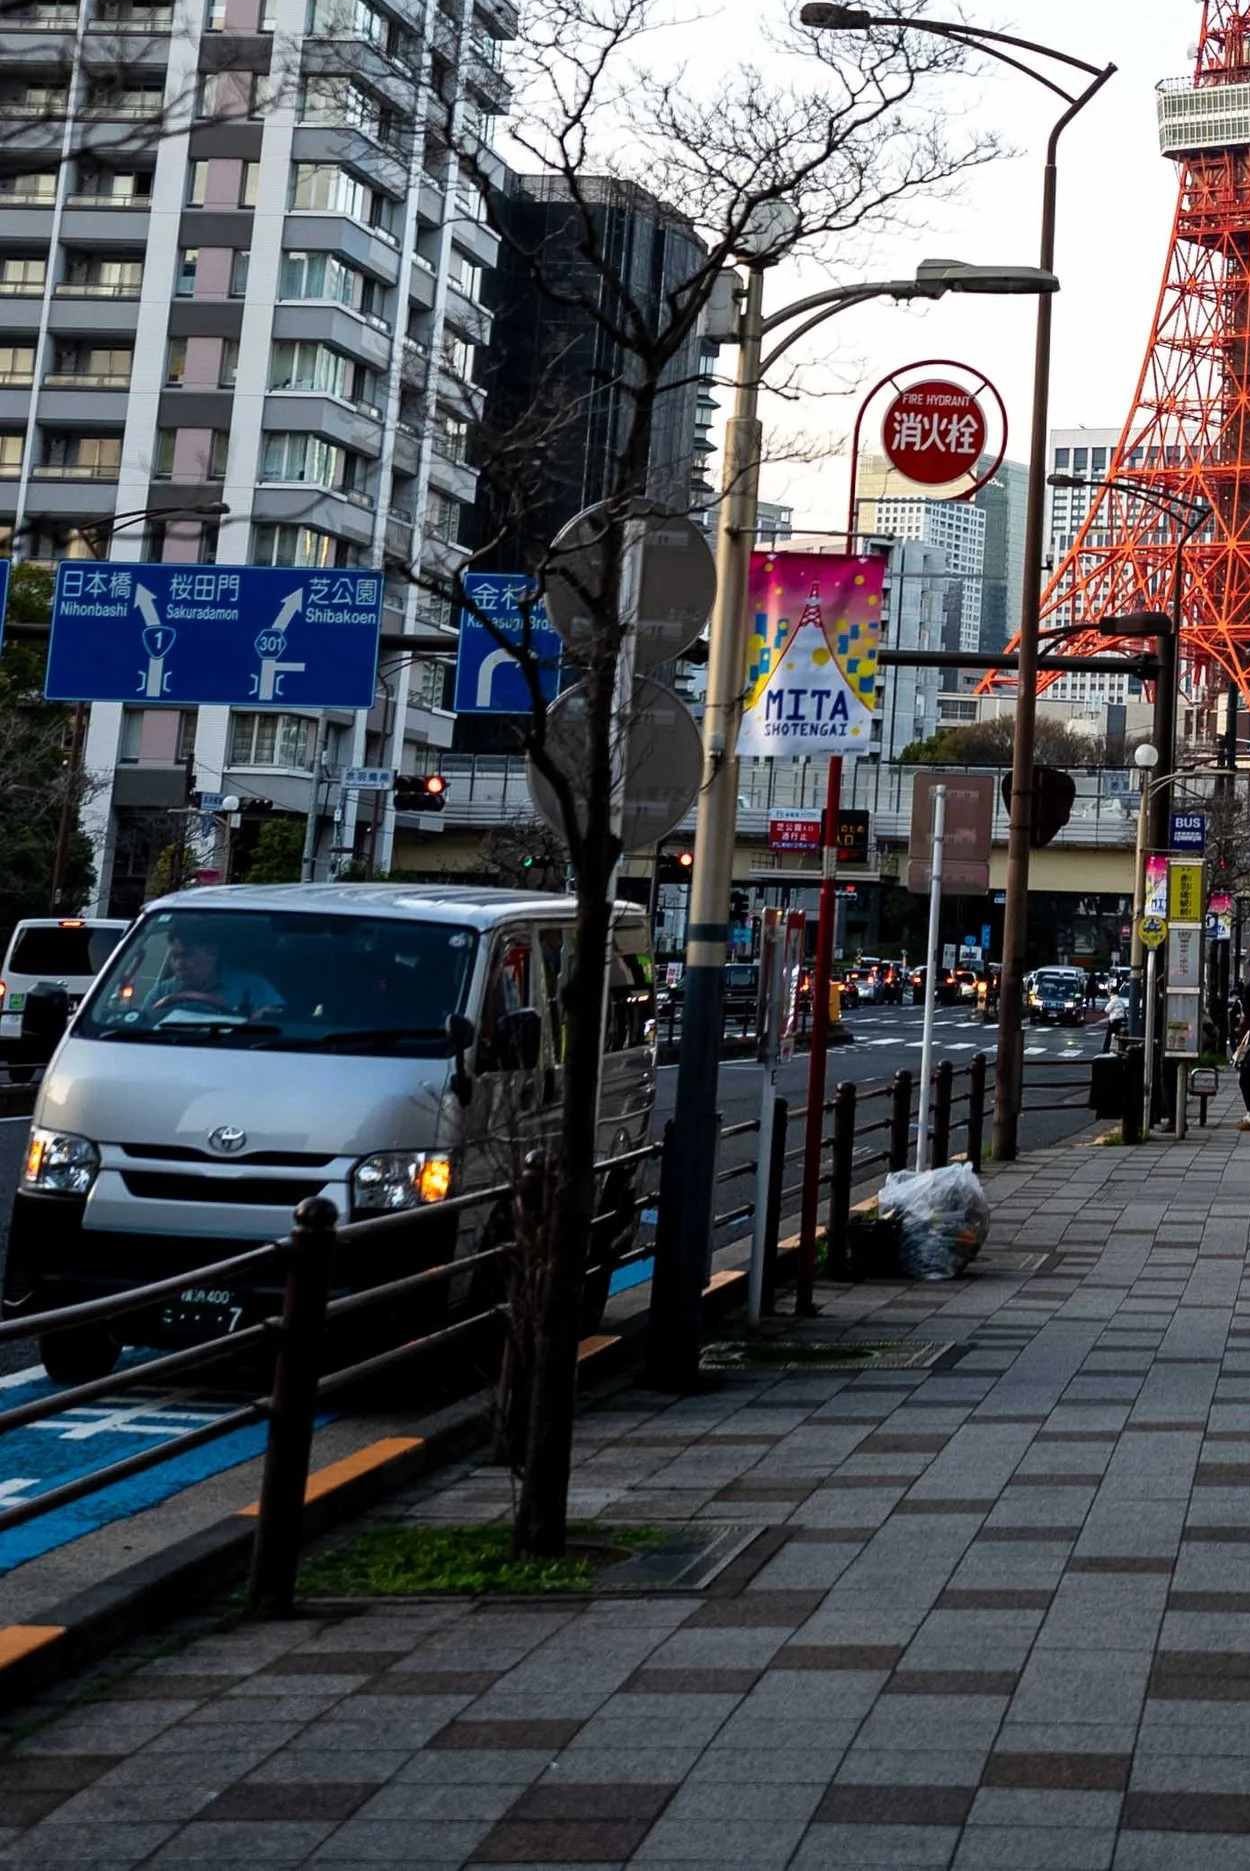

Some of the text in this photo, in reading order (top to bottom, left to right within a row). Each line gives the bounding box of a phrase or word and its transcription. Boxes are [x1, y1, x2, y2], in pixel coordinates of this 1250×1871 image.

[902, 393, 971, 407] FIRE HYDRANT
[891, 411, 978, 454] 消火栓
[62, 570, 133, 599] 日本橋
[169, 573, 241, 602] 桜田門
[306, 577, 378, 606] 芝公園
[60, 600, 128, 618] Nihonbashi
[166, 603, 240, 621] Sakuradamon
[304, 608, 377, 626] Shibakoen
[154, 631, 164, 649] 1
[258, 635, 283, 652] 301
[765, 689, 849, 721] MITA
[764, 722, 849, 737] SHOTENGAI
[1174, 817, 1201, 829] BUS
